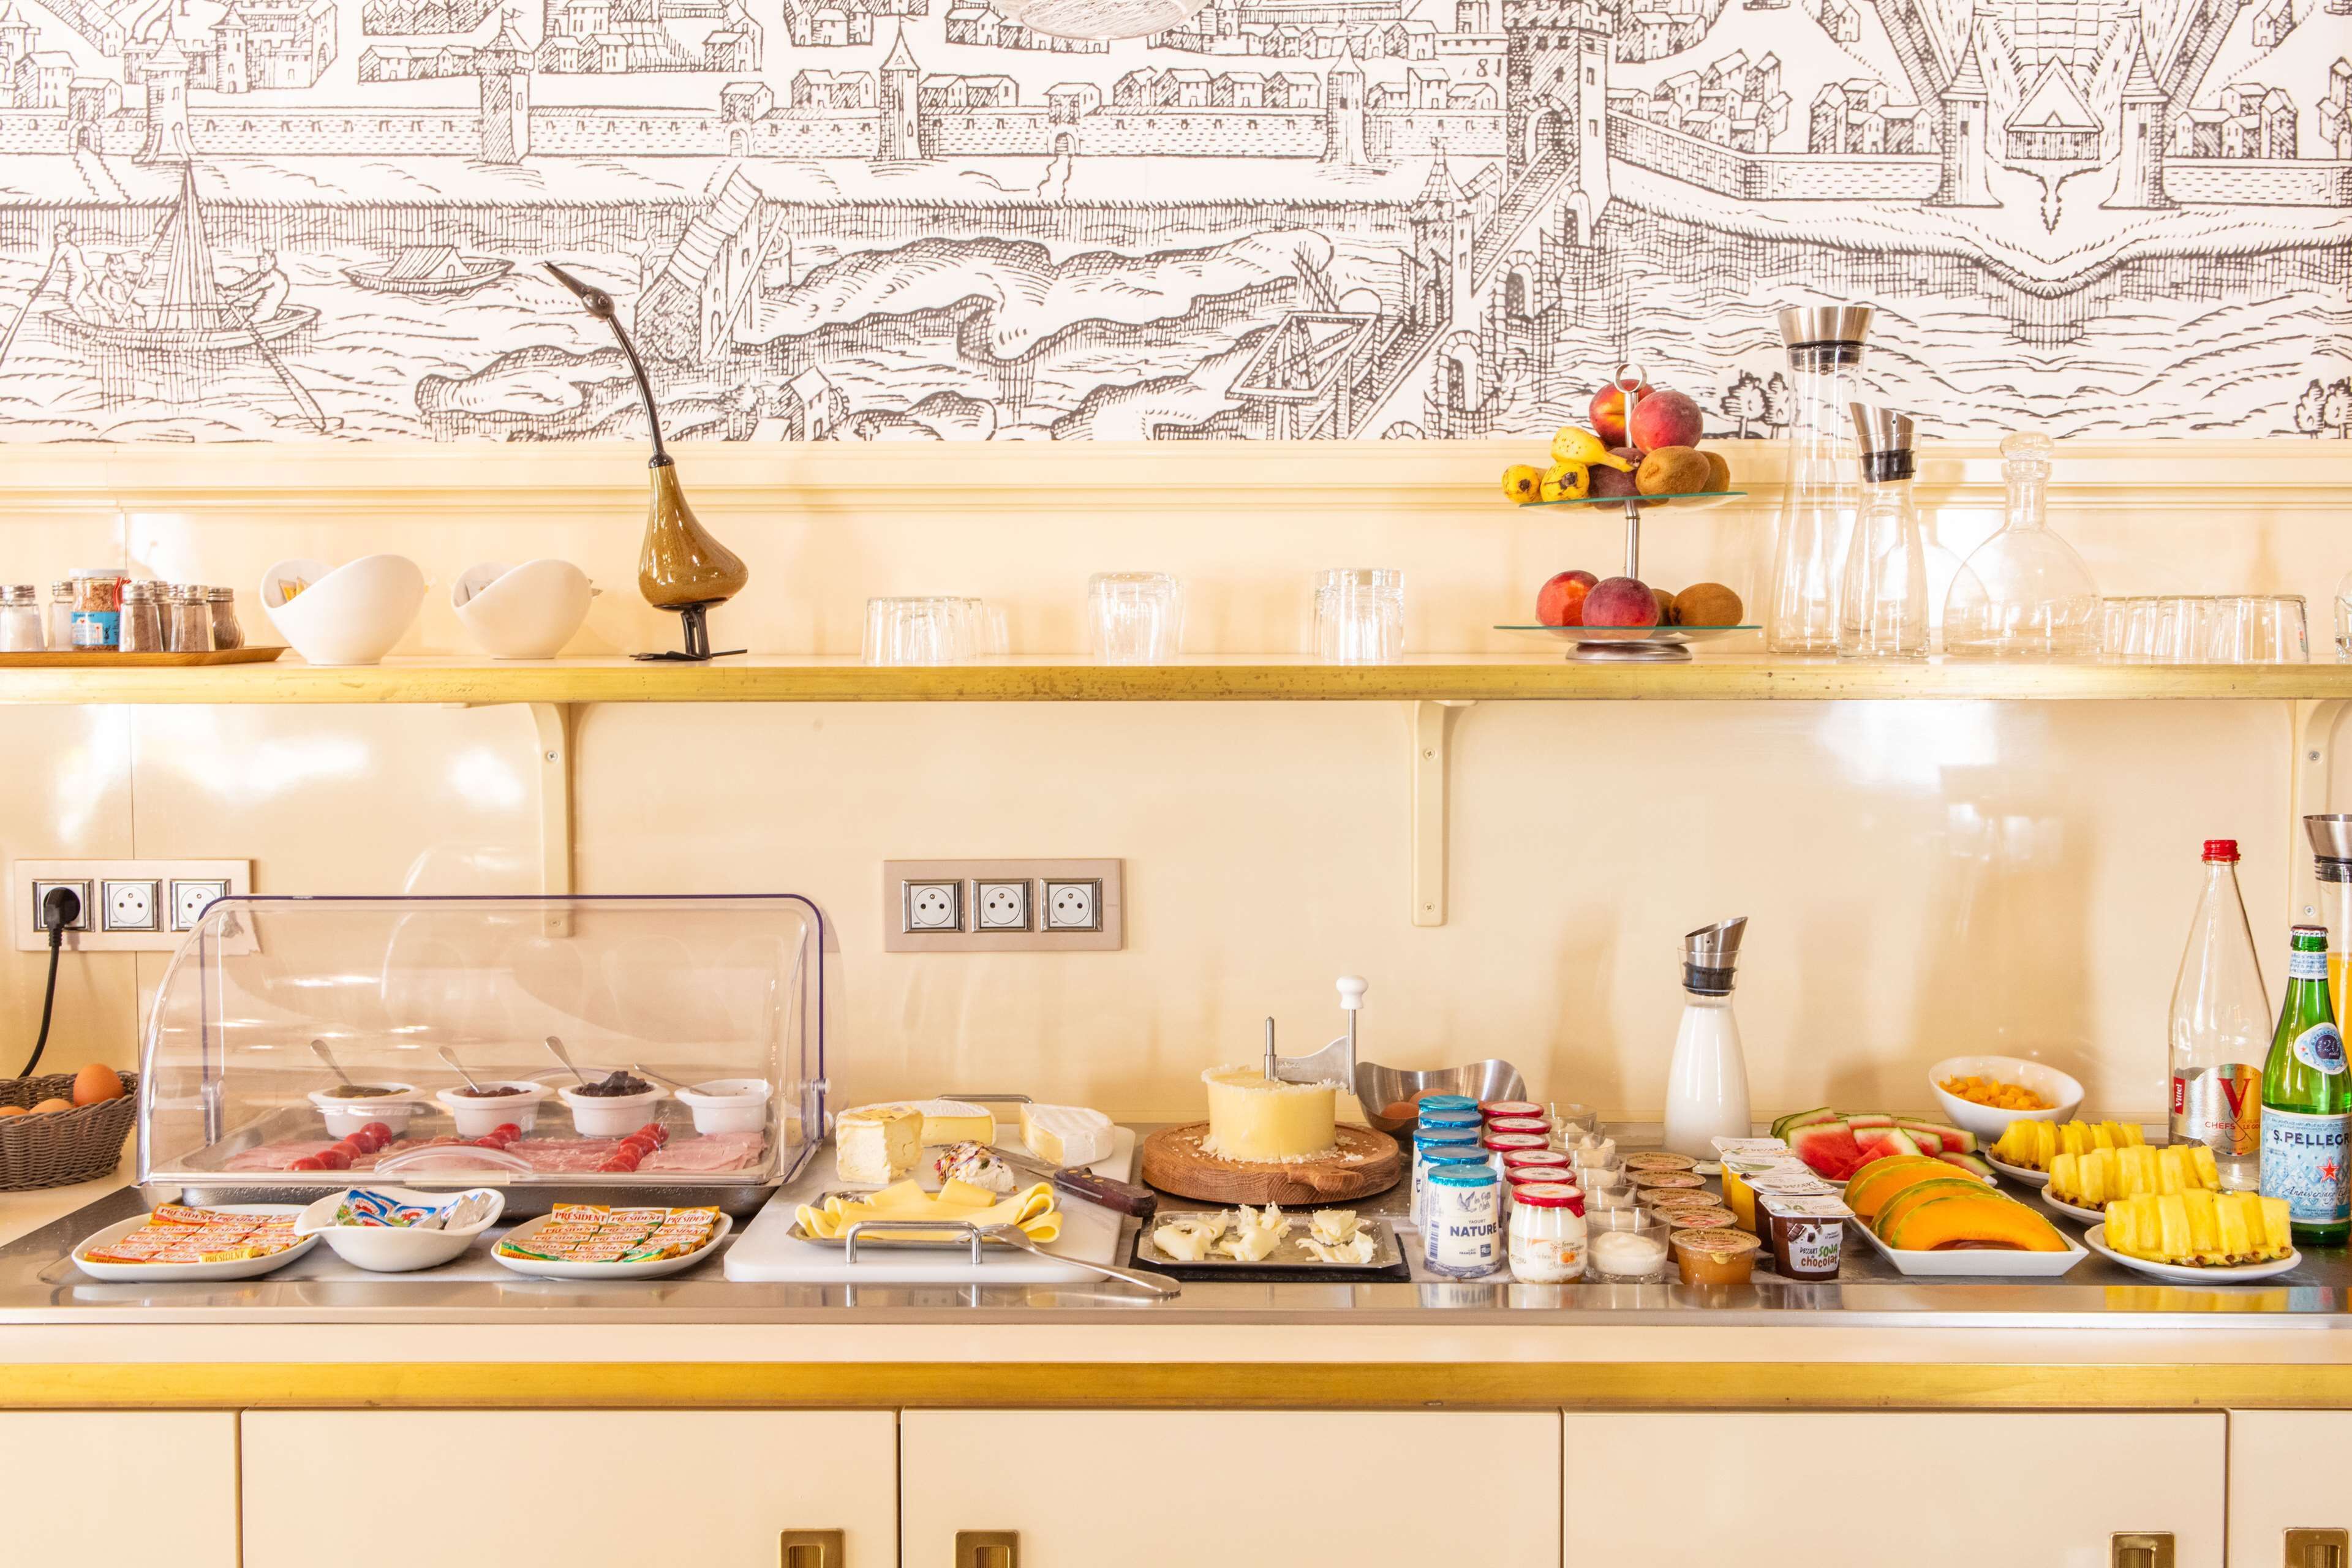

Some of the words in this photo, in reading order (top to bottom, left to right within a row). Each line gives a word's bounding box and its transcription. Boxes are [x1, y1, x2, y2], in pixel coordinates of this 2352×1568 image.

[2217, 1078, 2252, 1118] V
[2205, 1121, 2236, 1130] CHEFS
[1450, 1222, 1497, 1237] NATURE
[1818, 1243, 1838, 1257] SOJA
[1801, 1254, 1837, 1268] chocolat
